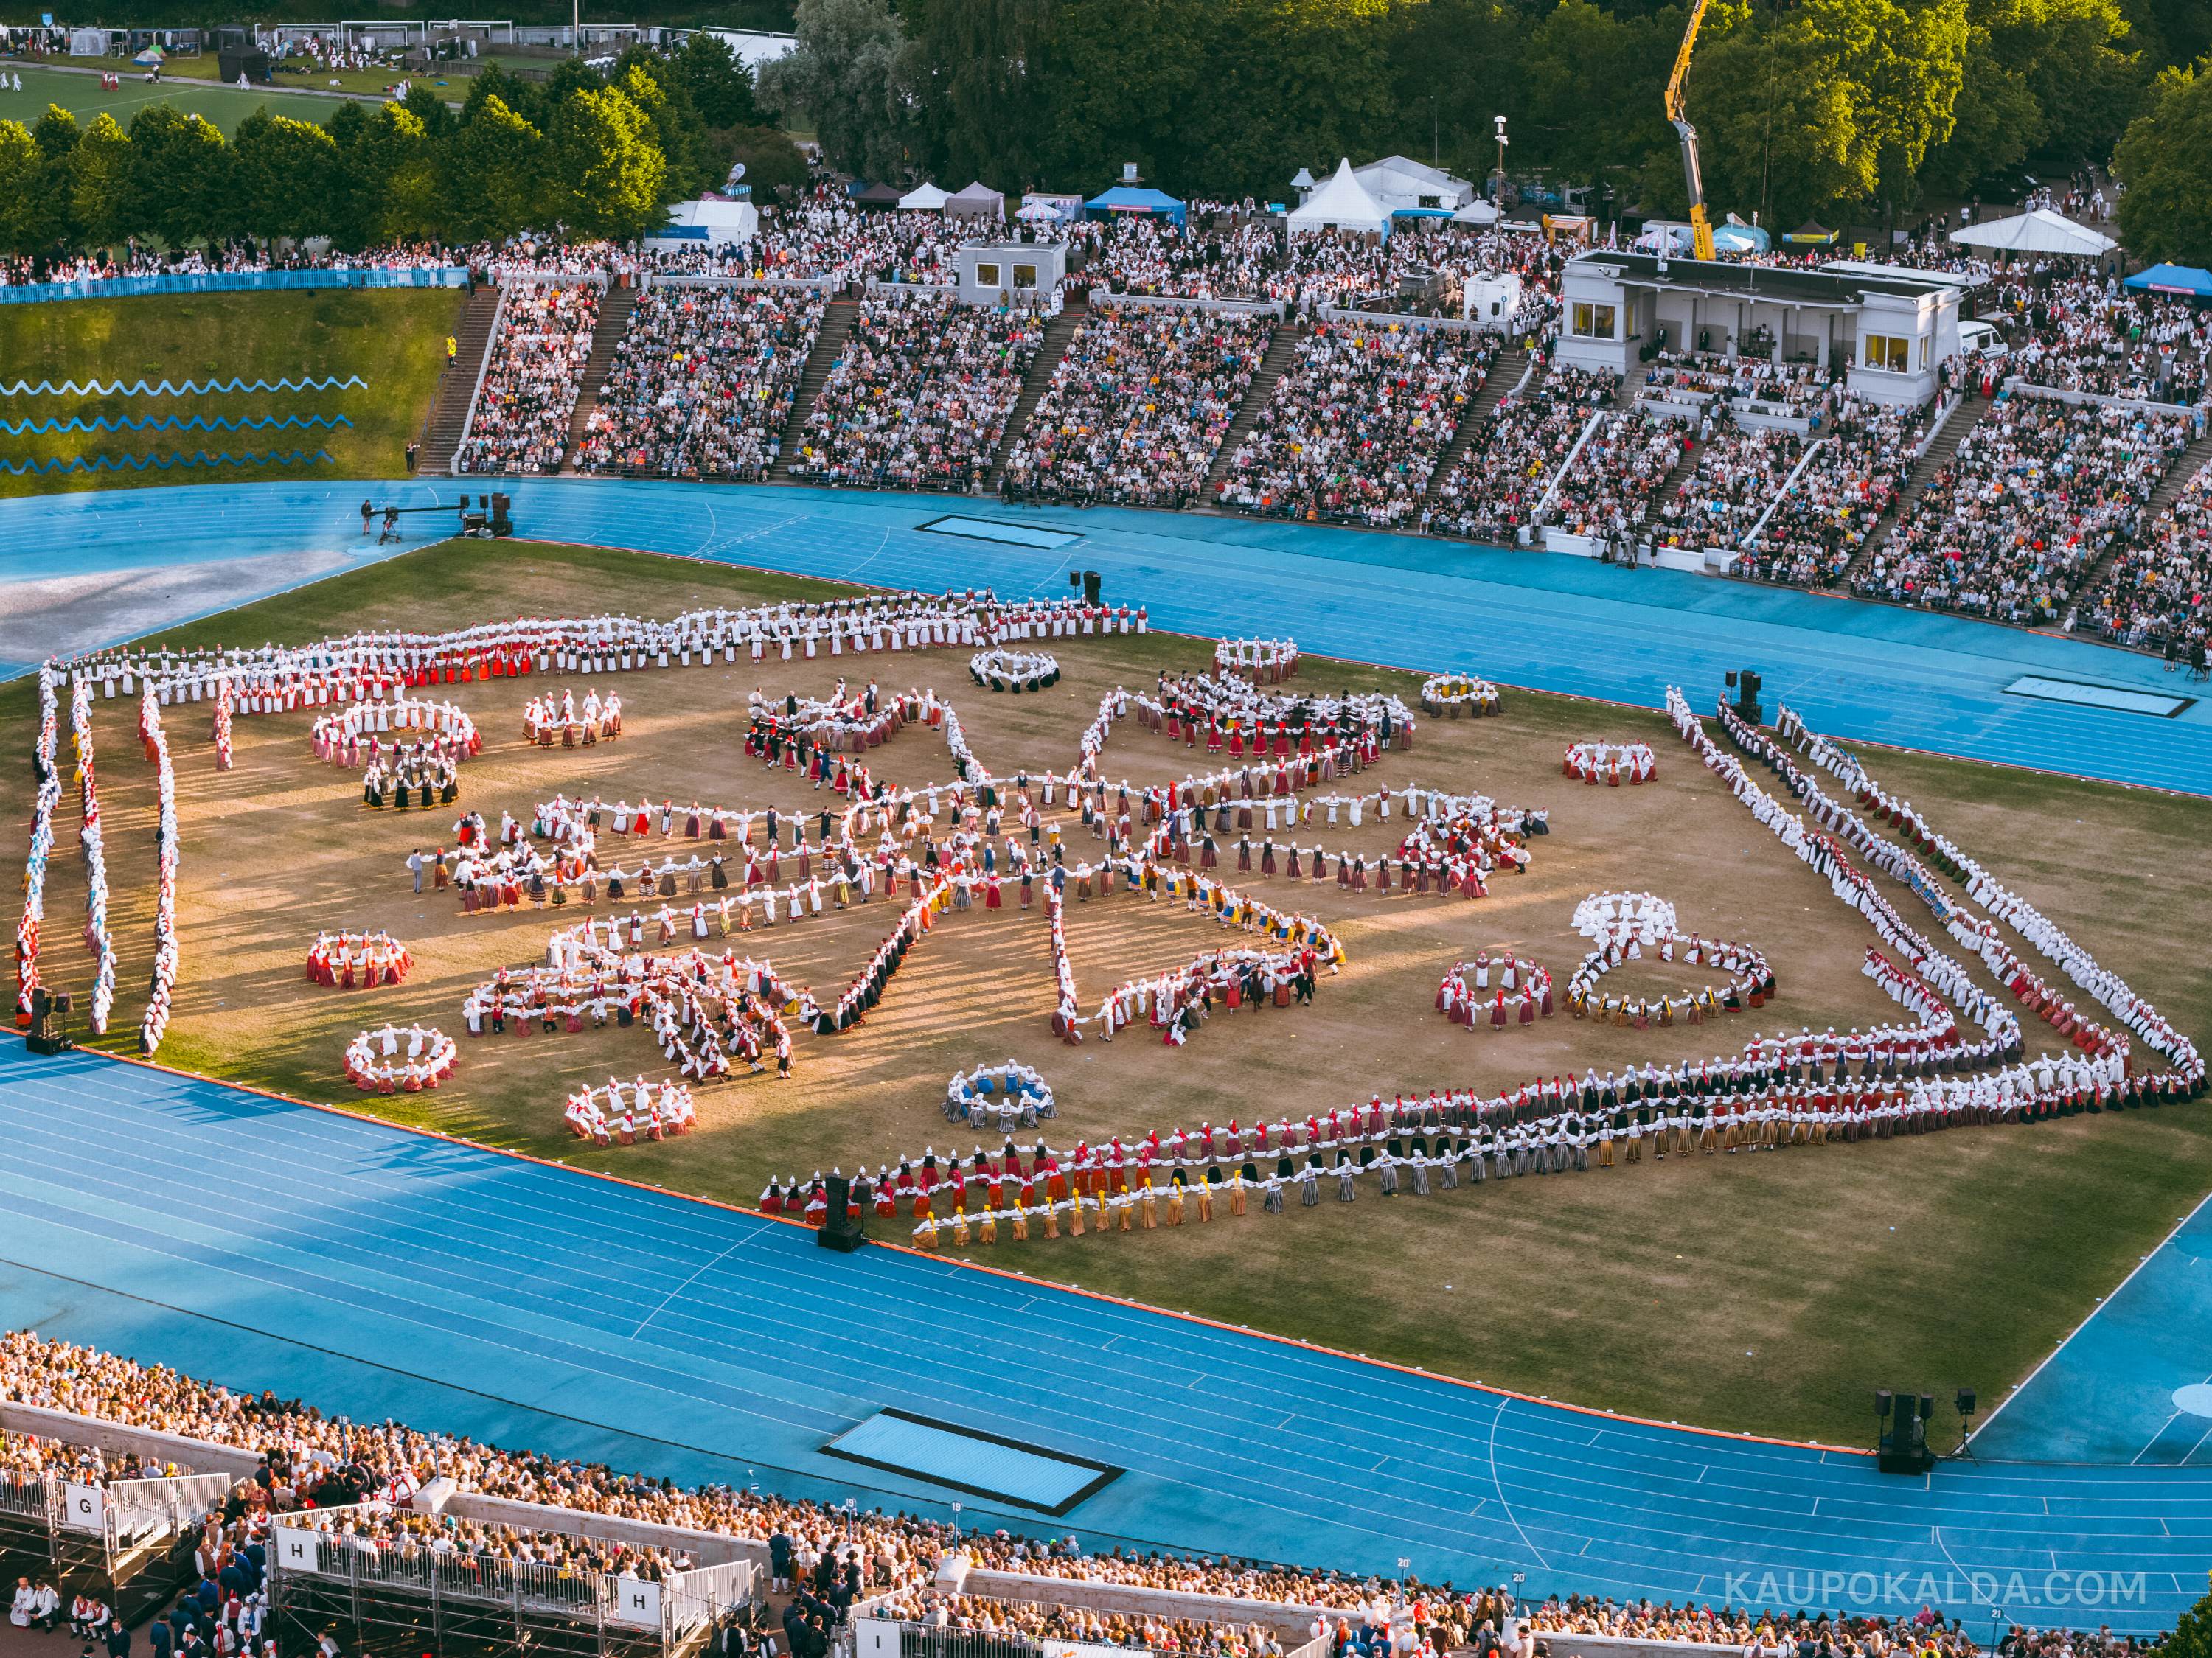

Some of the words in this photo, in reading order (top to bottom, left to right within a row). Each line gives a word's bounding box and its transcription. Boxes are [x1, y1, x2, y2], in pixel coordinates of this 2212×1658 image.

[80, 1499, 91, 1514] G
[846, 1497, 855, 1508] 19
[952, 1502, 961, 1511] 19
[291, 1543, 303, 1558] H
[1397, 1557, 1409, 1567] 20
[1512, 1573, 1525, 1582] 20
[633, 1594, 646, 1609] H
[1992, 1609, 2001, 1618] 21
[876, 1635, 880, 1649] I
